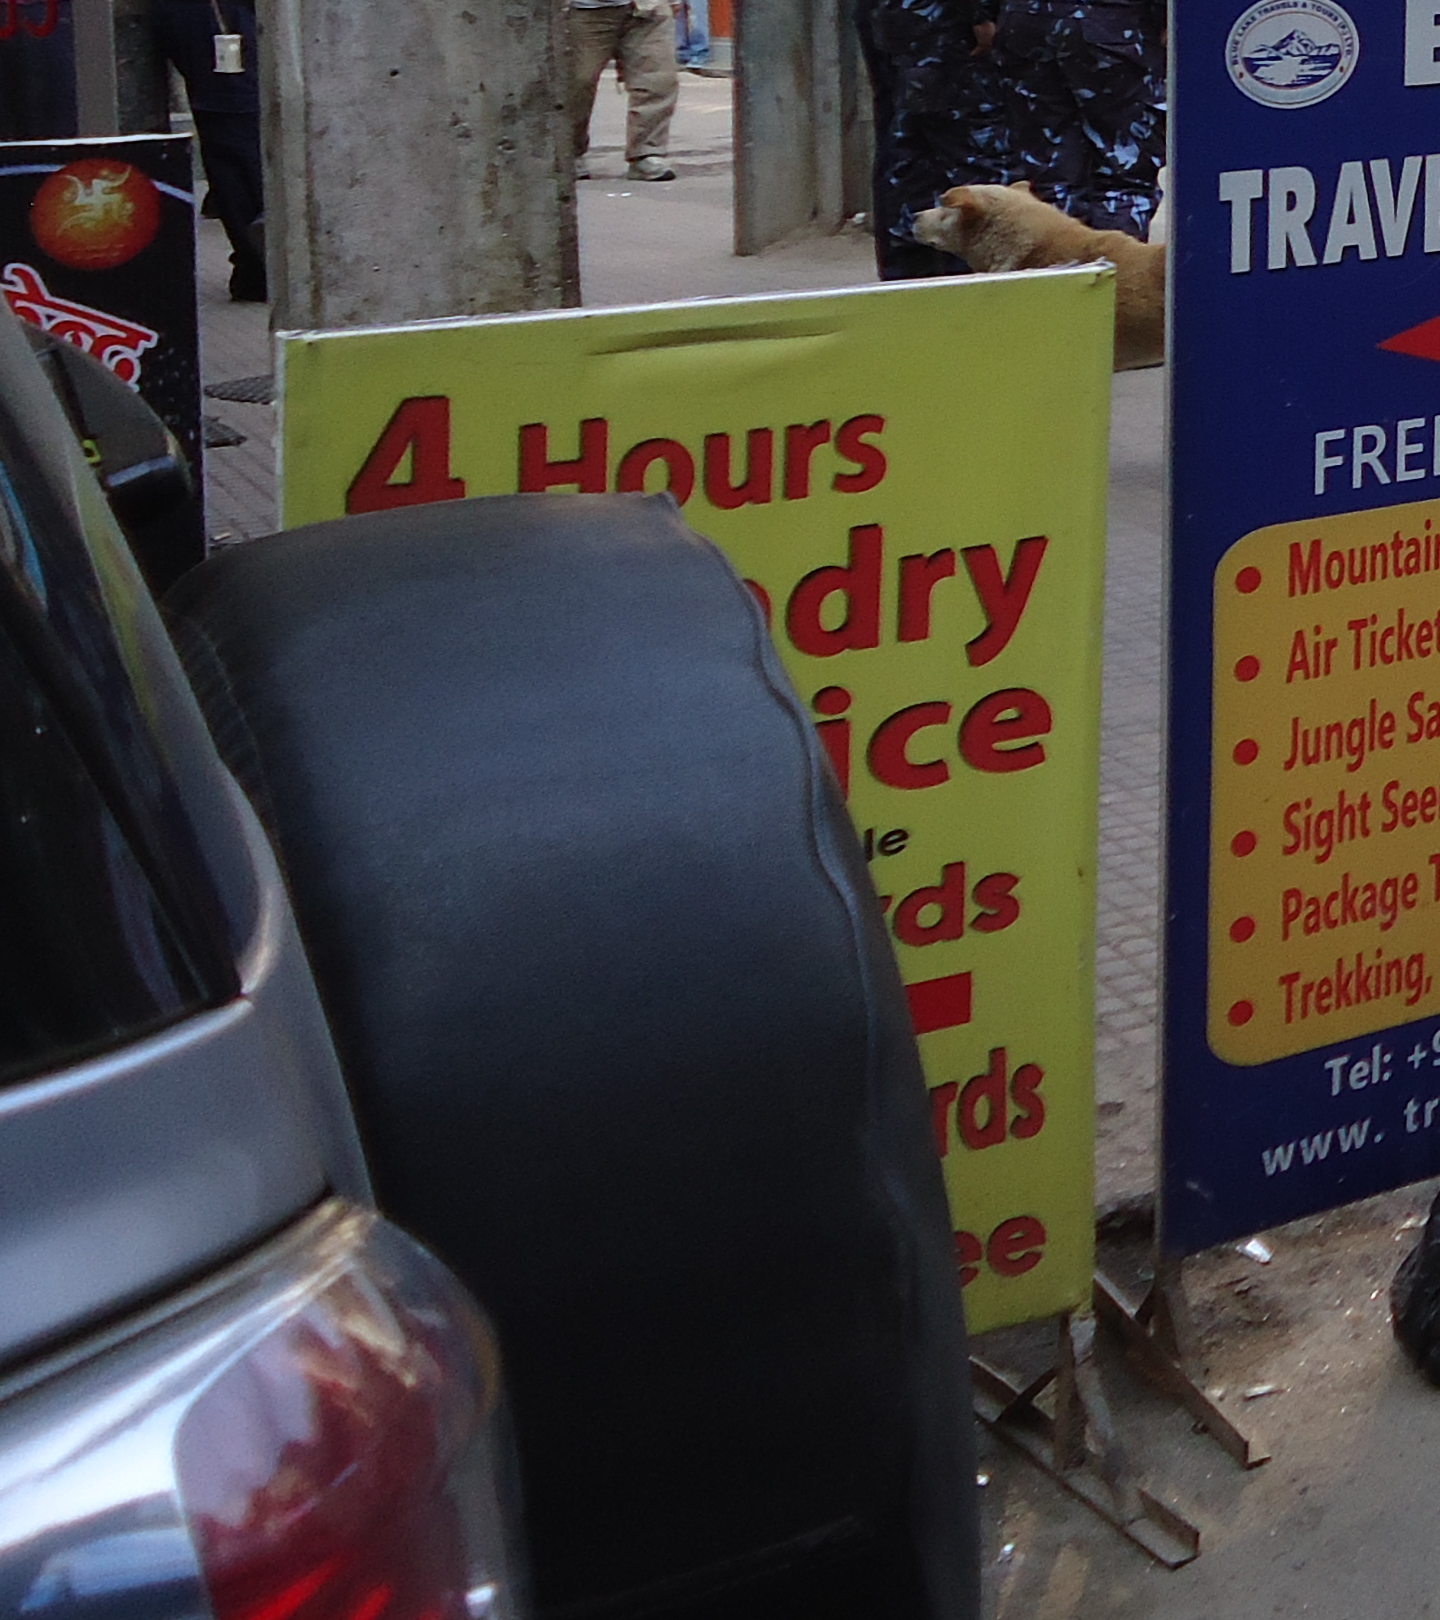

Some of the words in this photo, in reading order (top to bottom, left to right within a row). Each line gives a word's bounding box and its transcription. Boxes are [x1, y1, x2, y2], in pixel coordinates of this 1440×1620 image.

[517, 413, 888, 510] Hours
[1286, 623, 1339, 684] Air
[1284, 700, 1395, 773] Jungle
[1281, 794, 1371, 865] Sight
[1281, 863, 1418, 943] Package
[1280, 947, 1434, 1028] Trekking,
[1323, 1042, 1394, 1098] Tel:
